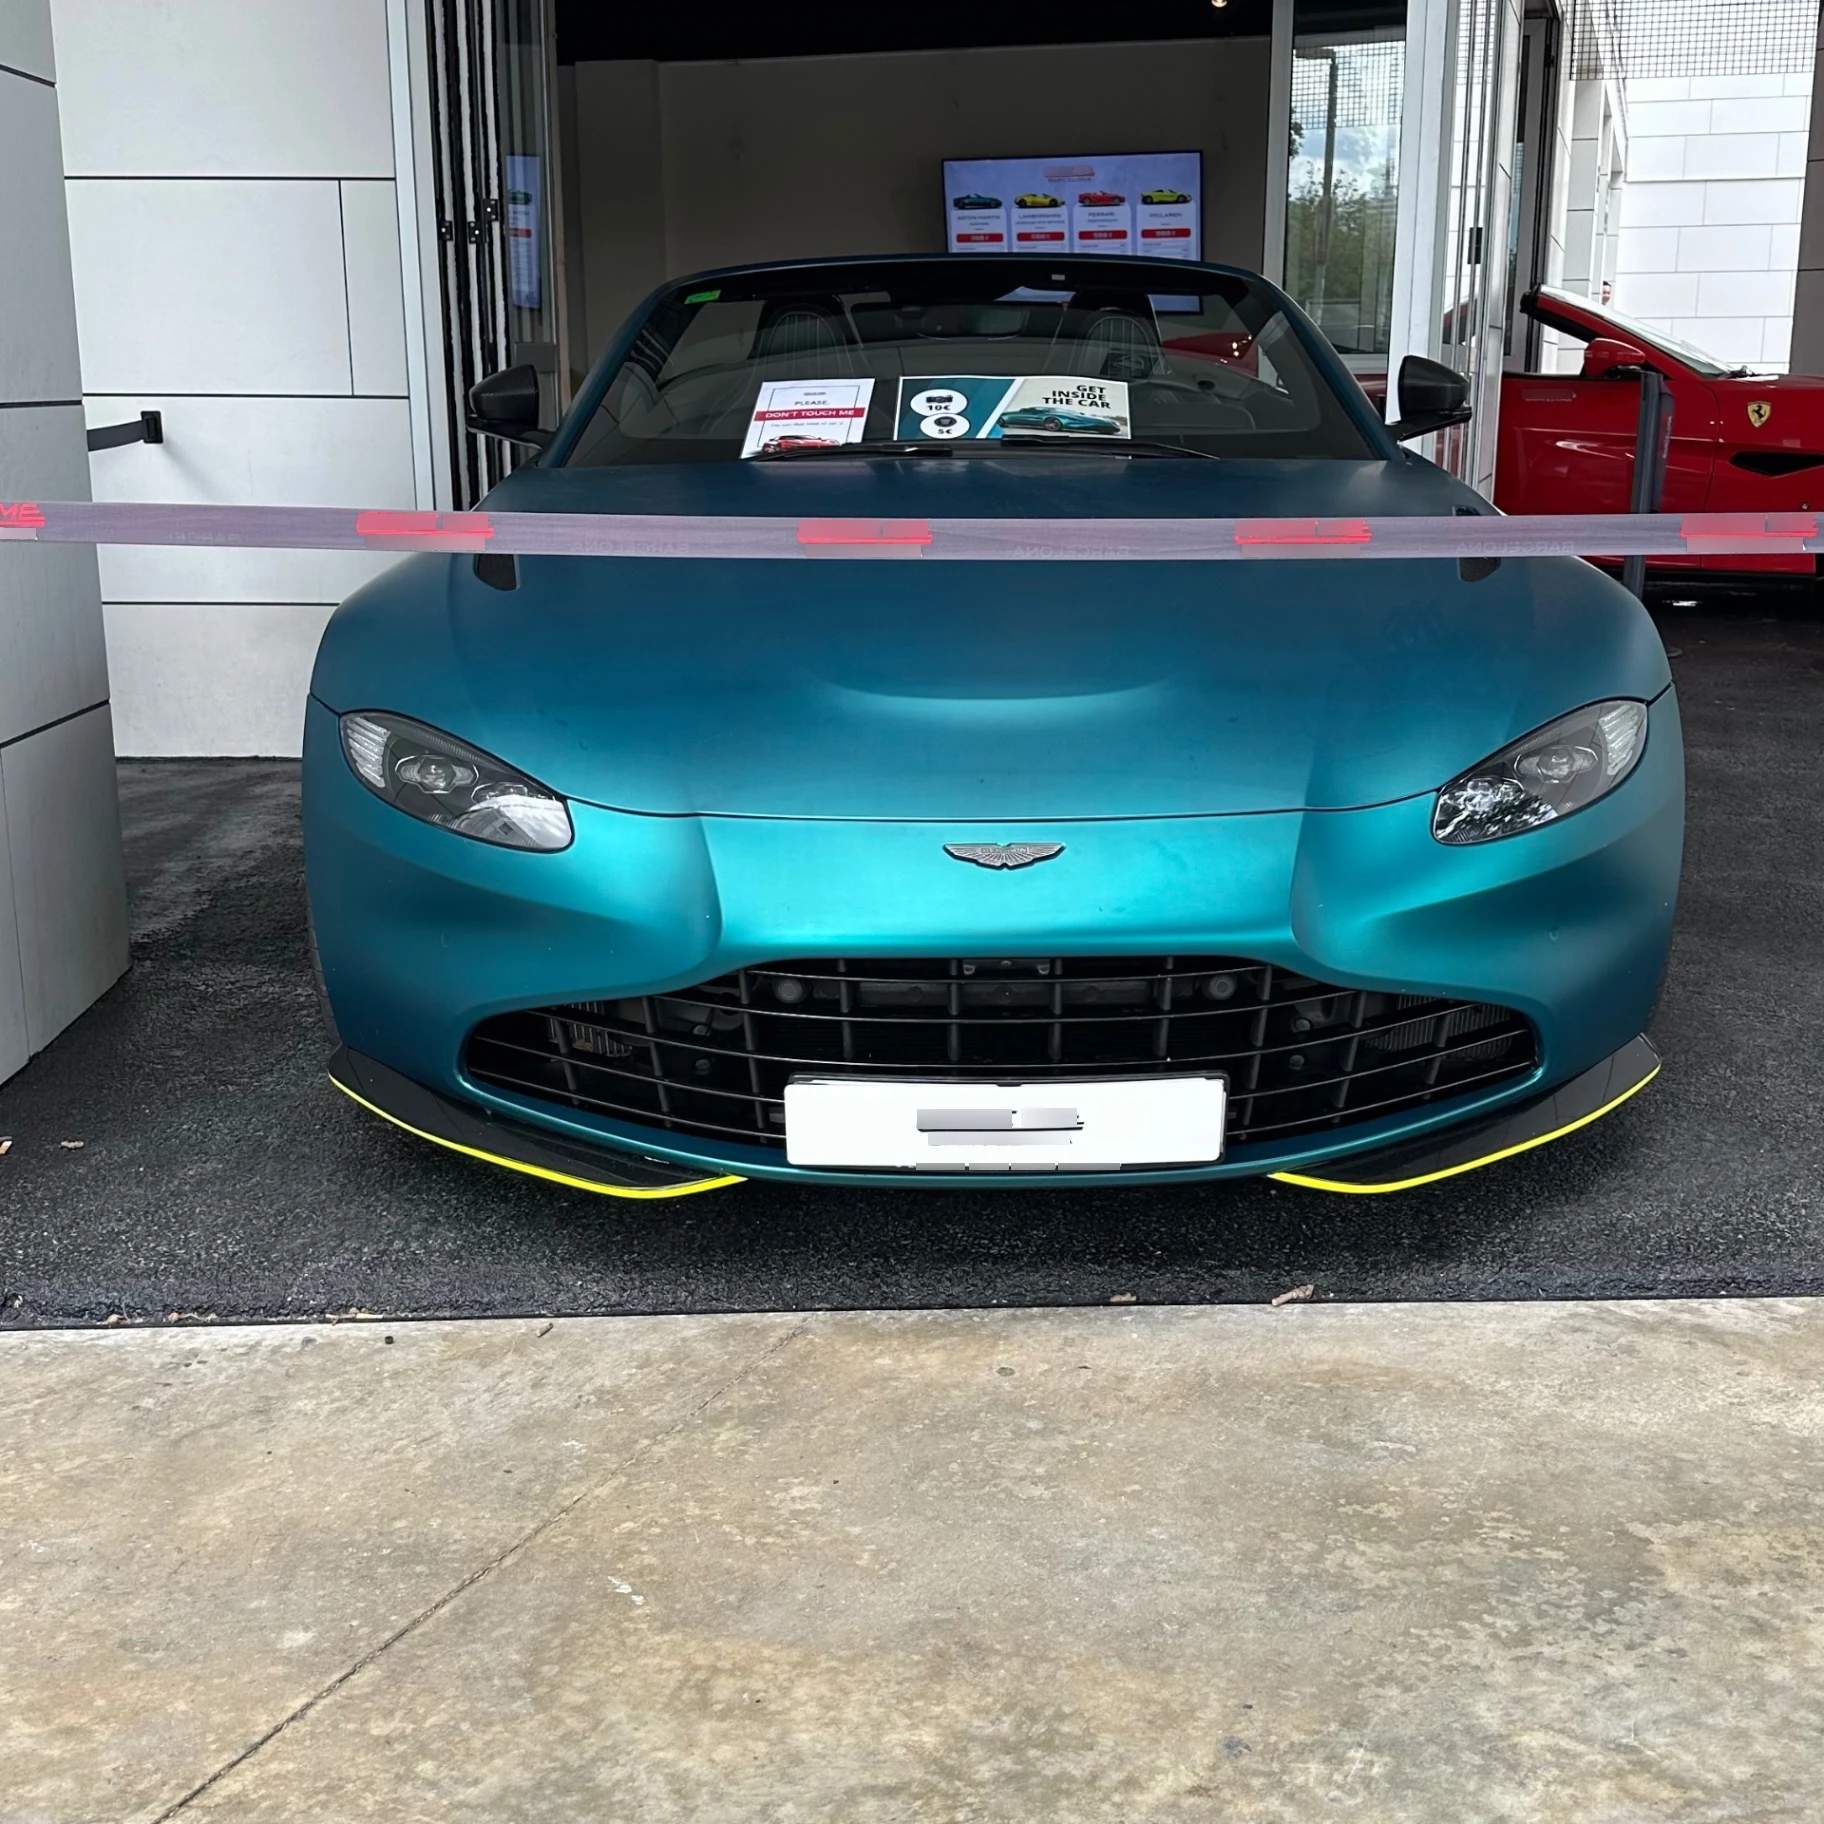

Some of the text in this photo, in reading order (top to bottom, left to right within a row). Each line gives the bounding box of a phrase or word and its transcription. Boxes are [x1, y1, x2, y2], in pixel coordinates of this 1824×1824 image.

[1076, 384, 1107, 394] GET
[1052, 390, 1106, 401] INSIDE
[1042, 397, 1111, 409] THE CAR
